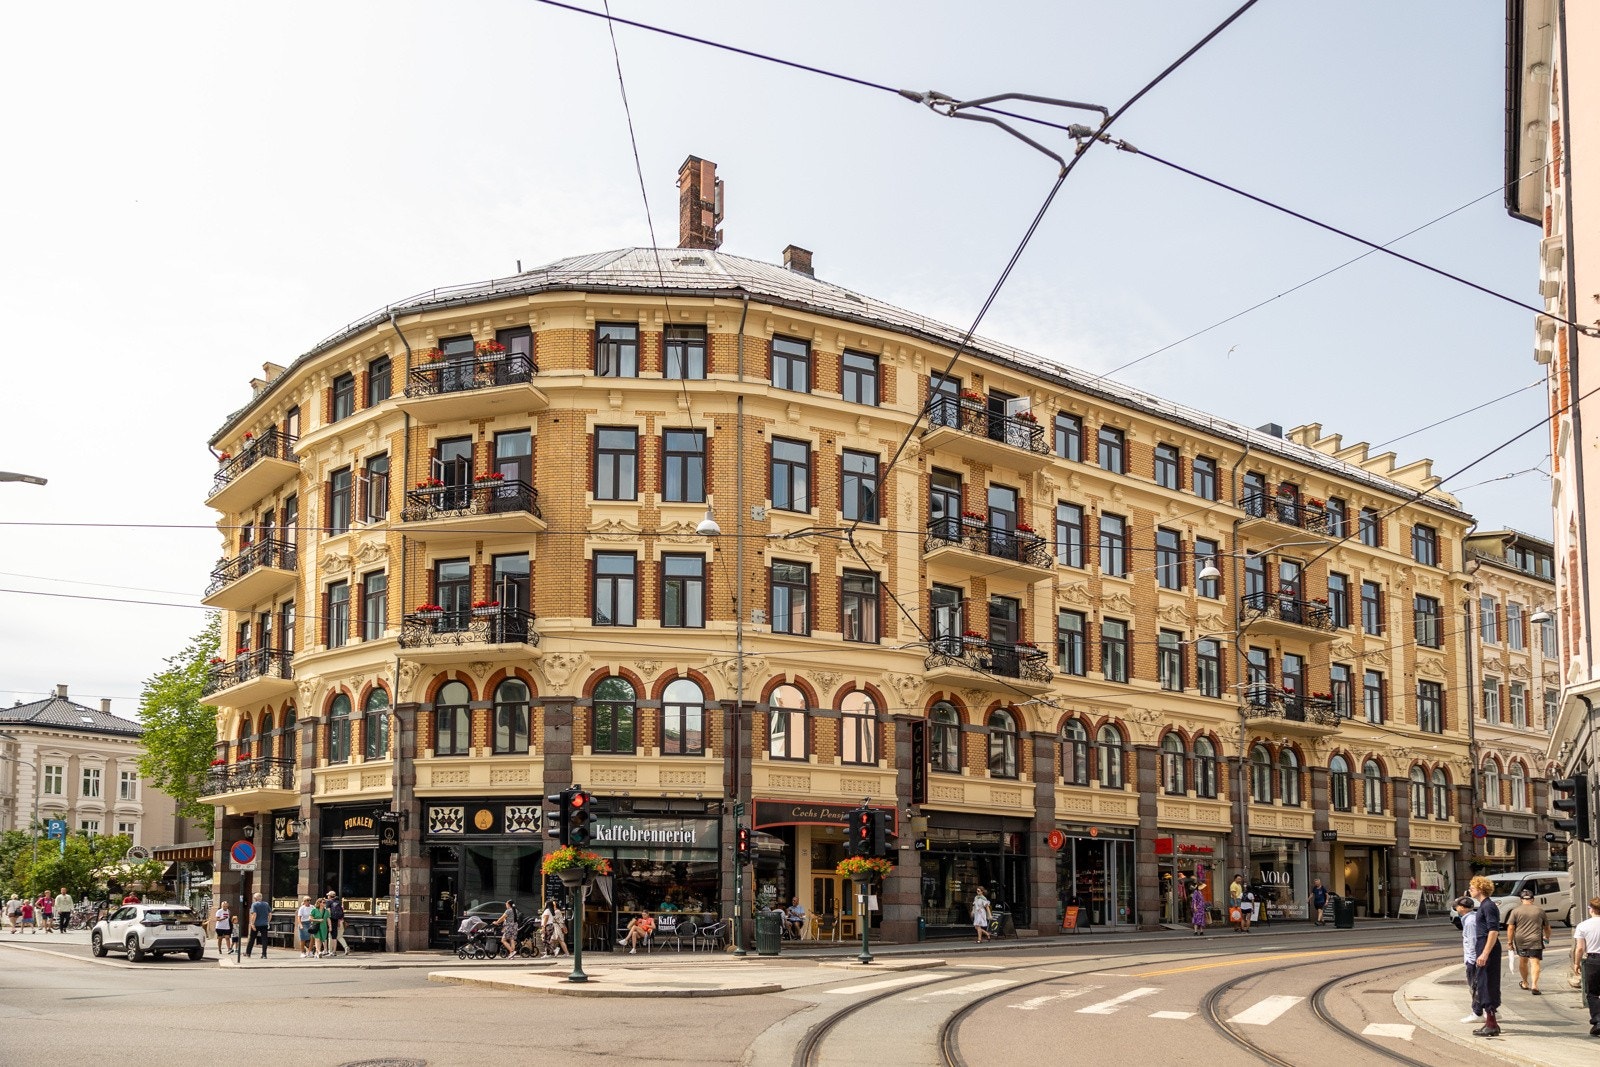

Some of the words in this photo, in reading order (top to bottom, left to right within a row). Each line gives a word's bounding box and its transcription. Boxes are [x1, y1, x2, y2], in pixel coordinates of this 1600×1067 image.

[914, 727, 923, 790] Cochs
[792, 807, 818, 818] Cochs
[820, 809, 846, 821] Pensj
[344, 817, 373, 830] POKALEN
[596, 824, 697, 844] Kaffebrenneriet
[1261, 870, 1290, 884] VOLO
[348, 901, 365, 910] MUSIKK
[379, 902, 389, 911] BAR
[658, 916, 676, 925] Kaffe
